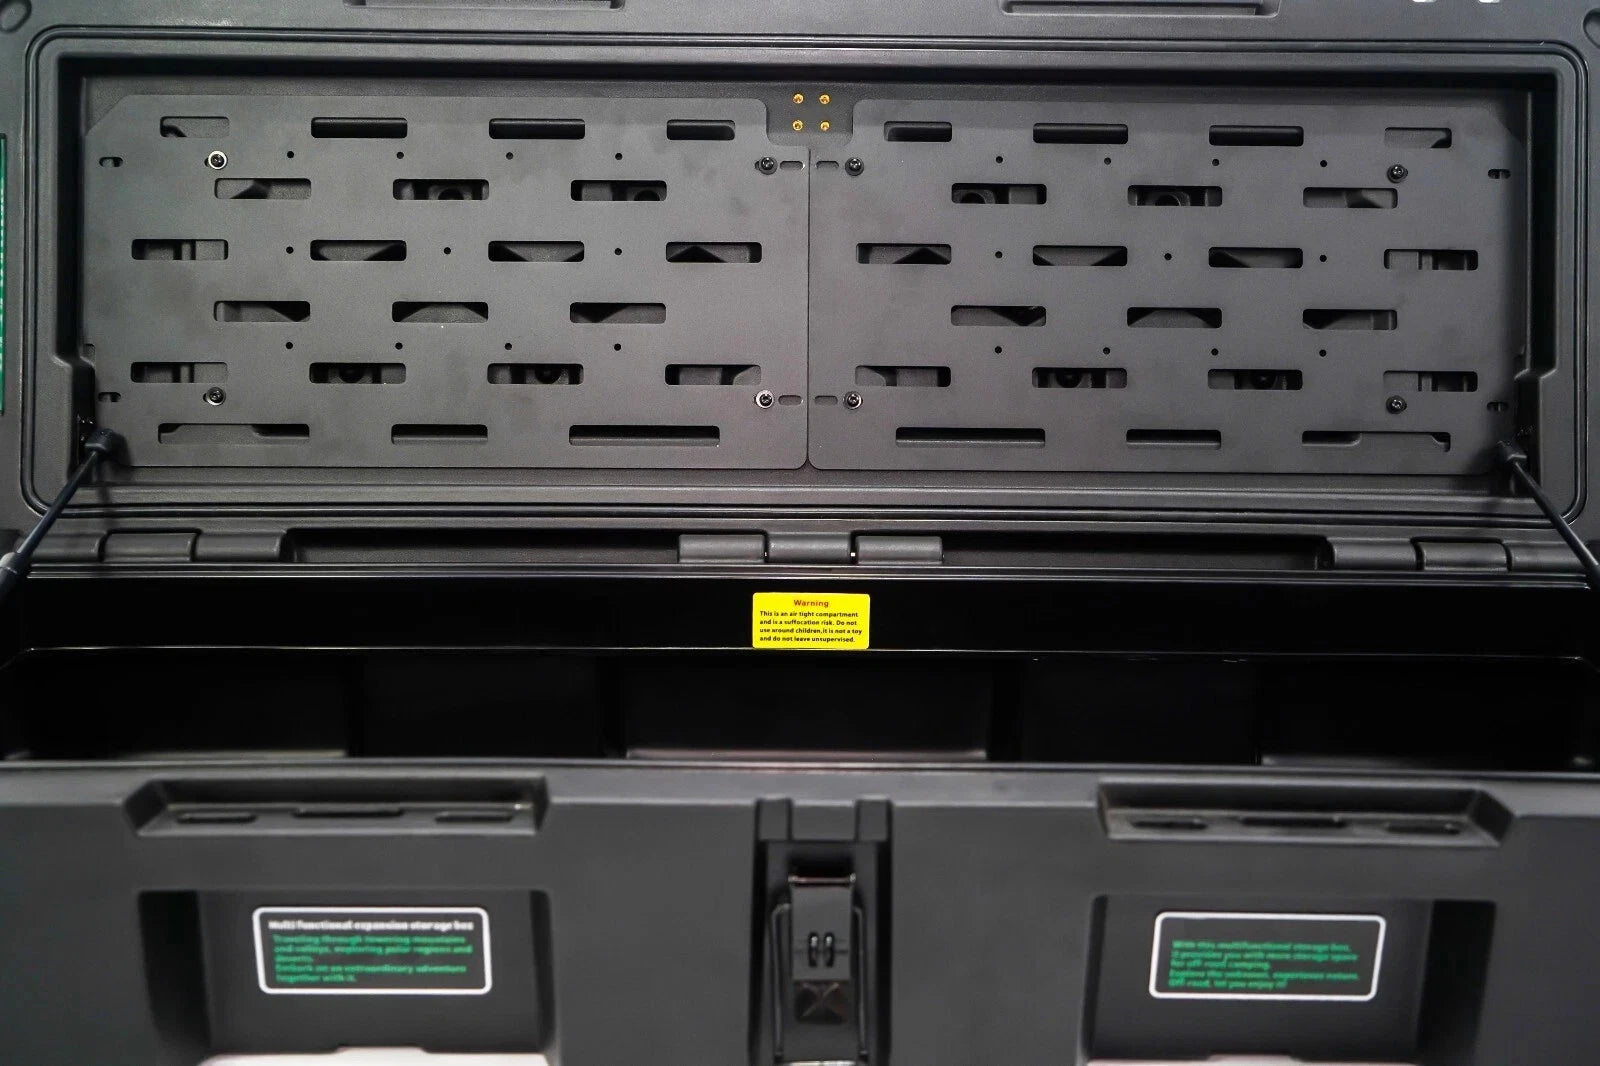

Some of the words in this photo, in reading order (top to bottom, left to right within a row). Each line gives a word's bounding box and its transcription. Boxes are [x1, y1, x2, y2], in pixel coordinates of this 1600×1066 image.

[793, 600, 830, 608] Warning
[799, 611, 815, 619] tight
[410, 921, 452, 932] storage
